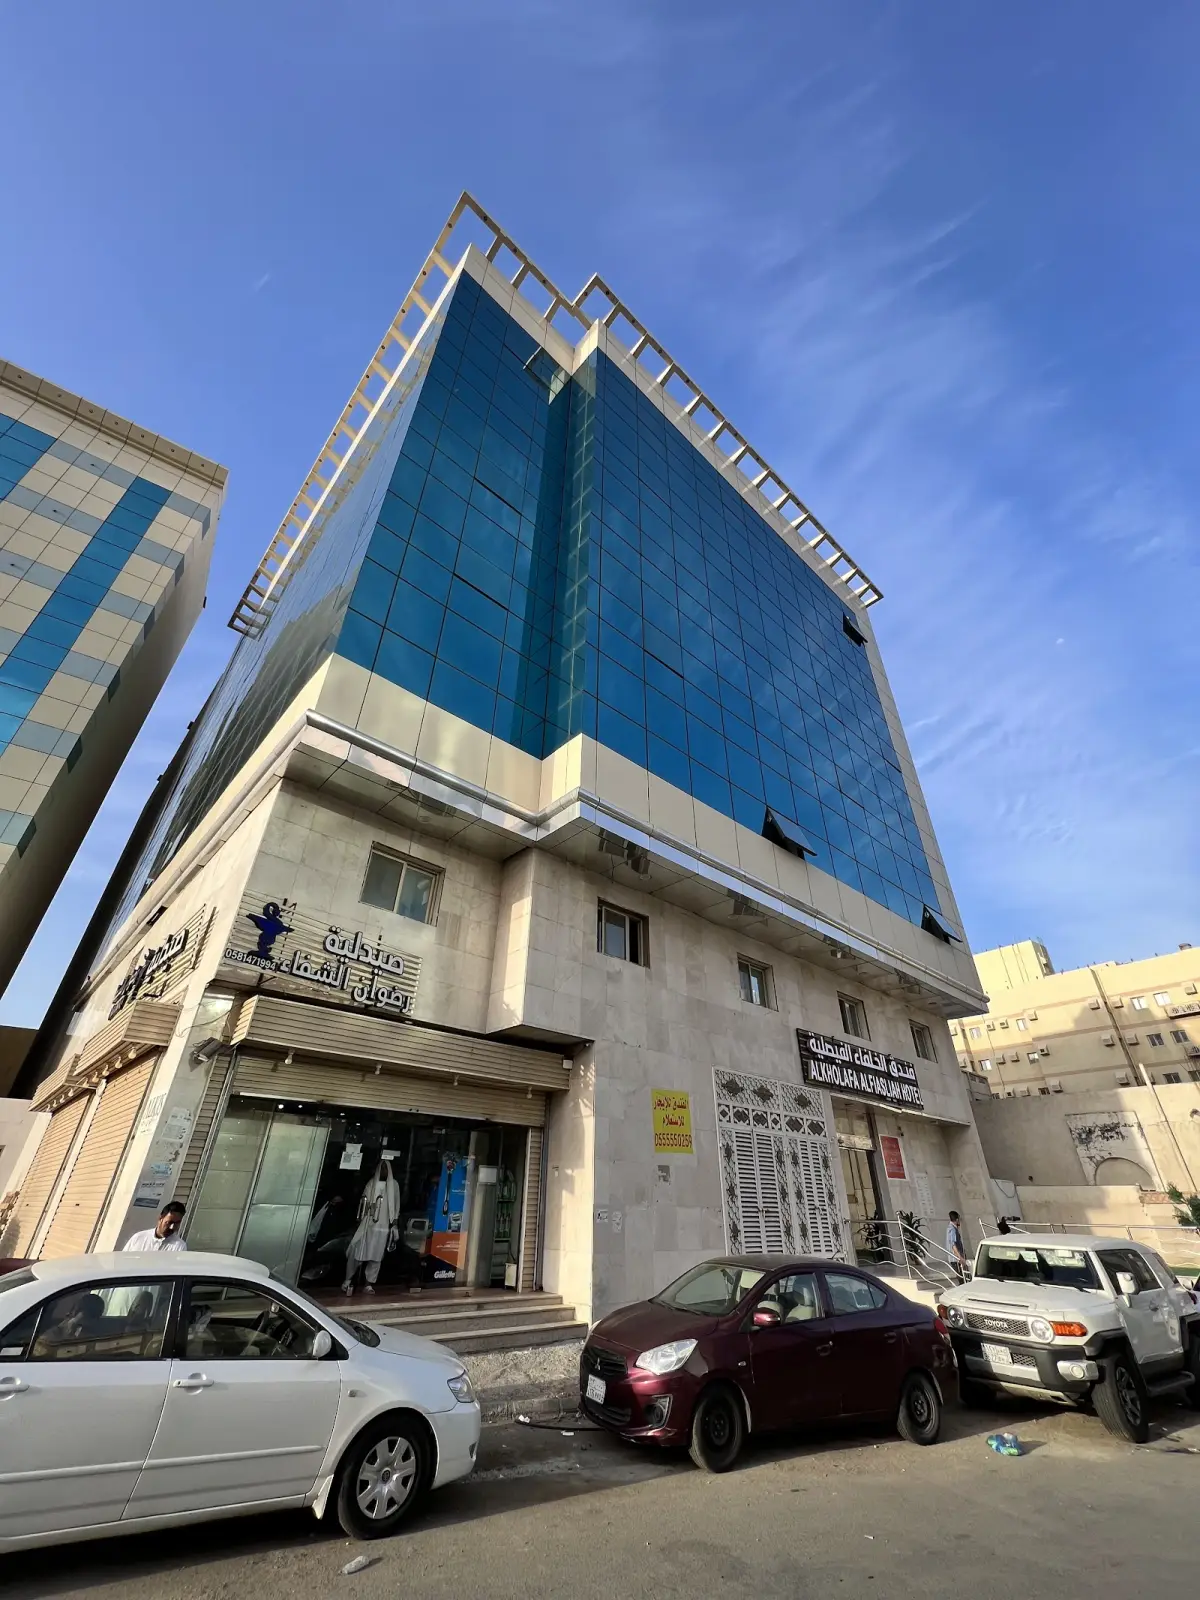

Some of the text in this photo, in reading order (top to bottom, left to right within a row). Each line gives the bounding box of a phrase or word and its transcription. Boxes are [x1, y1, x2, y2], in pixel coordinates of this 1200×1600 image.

[225, 948, 276, 970] 0581471994
[324, 925, 404, 975] صيدلية
[280, 950, 411, 1013] رضوان الشفاء
[808, 1031, 916, 1080] فندق الخلفاء الفيصلية
[811, 1060, 860, 1090] ALKHOLAFA
[901, 1084, 924, 1106] HOTEL
[434, 1270, 455, 1279] Gillette
[984, 1319, 1008, 1329] TOYOTA
